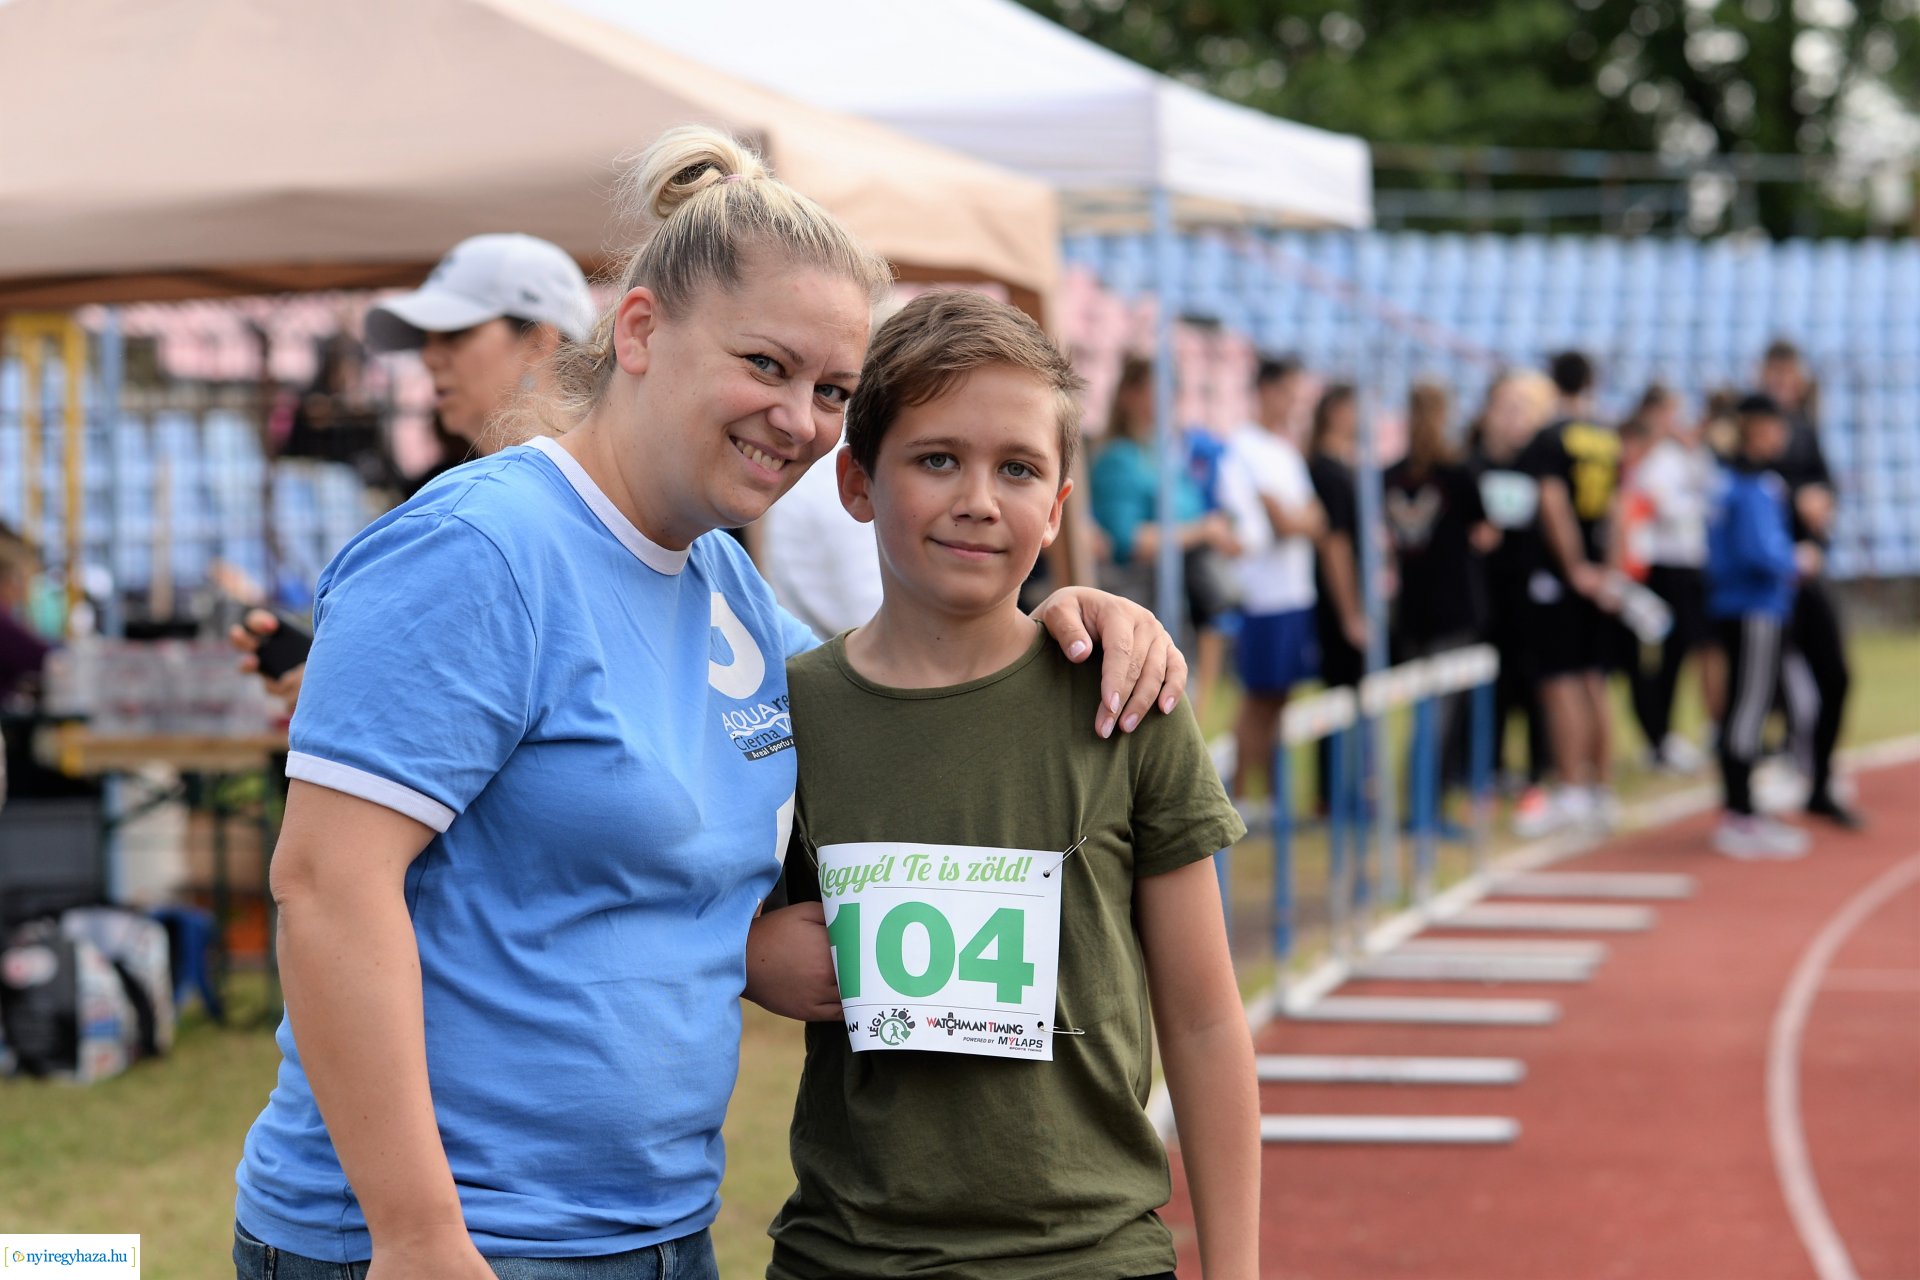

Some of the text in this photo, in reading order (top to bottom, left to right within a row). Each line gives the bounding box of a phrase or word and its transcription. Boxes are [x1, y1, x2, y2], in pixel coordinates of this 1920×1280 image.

[902, 854, 932, 882] Te
[938, 856, 960, 882] is
[966, 856, 1033, 883] zöld!
[827, 901, 1035, 1005] 104
[926, 1016, 1024, 1035] WATCHMAN TIMING
[997, 1036, 1044, 1049] MYLAPS
